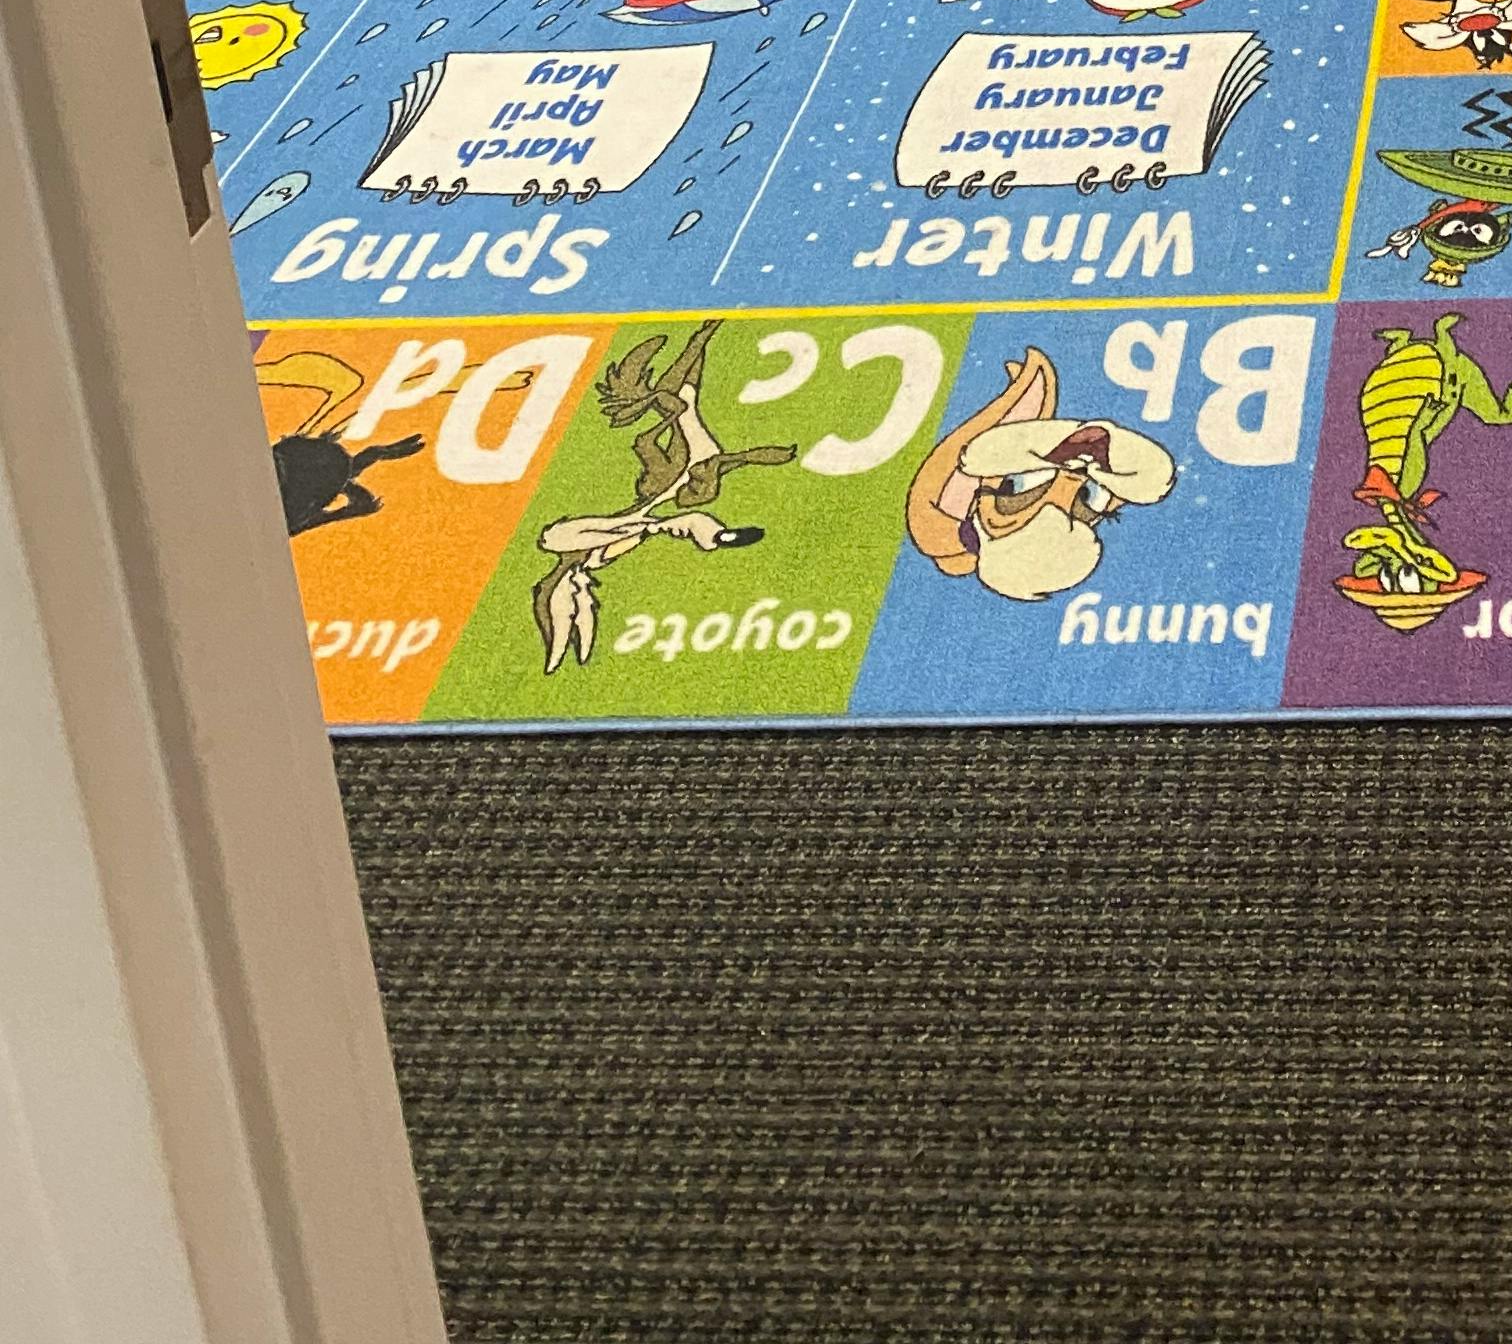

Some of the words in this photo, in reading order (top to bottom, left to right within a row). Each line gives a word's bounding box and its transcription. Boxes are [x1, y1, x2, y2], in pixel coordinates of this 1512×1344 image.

[525, 58, 617, 88] May
[987, 43, 1190, 72] February
[491, 97, 603, 129] April
[975, 84, 1164, 110] January
[458, 137, 594, 167] March
[941, 124, 1171, 156] December
[271, 214, 611, 303] Spring
[853, 214, 1195, 284] Winter
[344, 333, 596, 484] Dd
[738, 325, 944, 475] Cc
[1103, 315, 1318, 467] Bb
[613, 598, 853, 662] coyote
[1058, 592, 1273, 658] bunny
